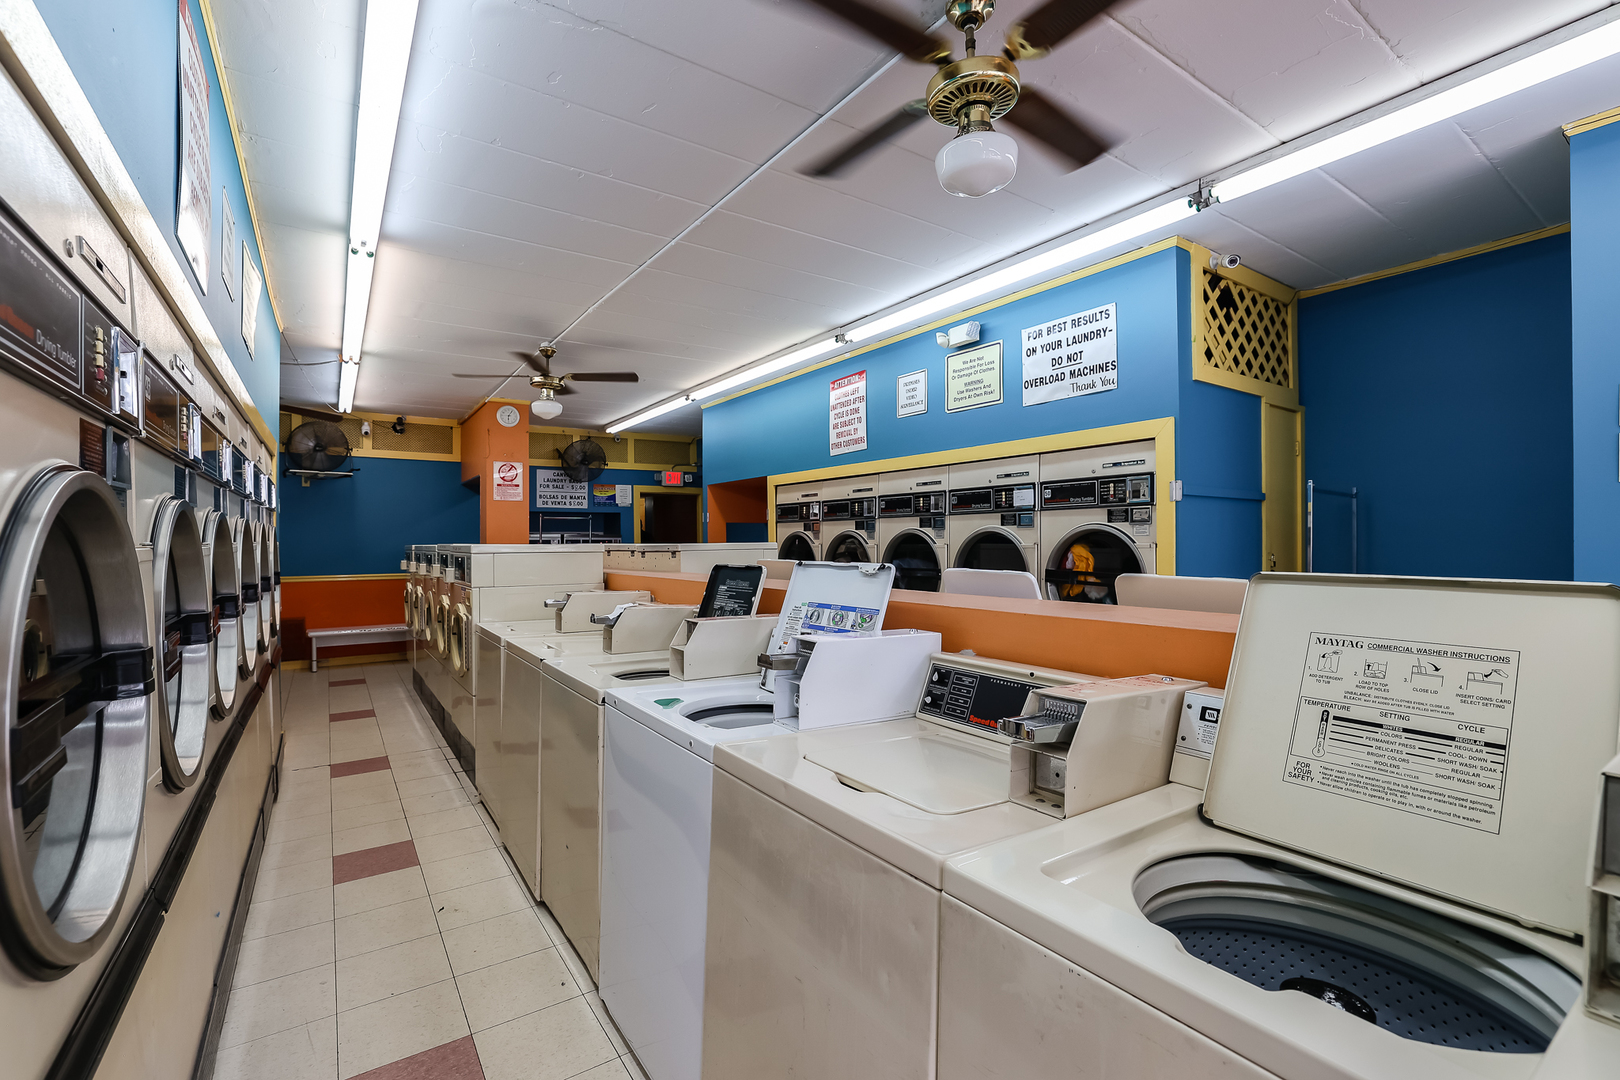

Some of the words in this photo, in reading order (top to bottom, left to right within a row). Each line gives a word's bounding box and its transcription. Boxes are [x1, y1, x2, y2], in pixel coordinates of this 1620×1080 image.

[1027, 328, 1043, 341] FOR
[1046, 321, 1067, 336] BEST
[1071, 309, 1110, 329] RESULTS
[36, 328, 57, 359] Drying
[57, 343, 77, 370] Tumbler
[1026, 346, 1037, 357] ON
[1040, 339, 1062, 353] YOUR
[1066, 327, 1113, 347] LAUNDRY-
[1051, 356, 1063, 367] DO
[1066, 350, 1083, 363] NOT
[952, 364, 976, 374] Responsible
[1024, 371, 1066, 390] OVERLOAD
[1069, 360, 1117, 380] MACHINES
[965, 385, 982, 393] Washers
[1070, 380, 1097, 393] Thank
[1100, 375, 1115, 387] You
[850, 387, 860, 397] LEFT
[831, 399, 851, 412] UNATTENDED
[852, 395, 865, 405] AFTER
[834, 410, 845, 421] CYCLE
[845, 409, 849, 417] IS
[849, 406, 860, 415] DONE
[840, 418, 856, 429] SUBJECT
[857, 416, 862, 424] TO
[836, 429, 853, 440] REMOVAL
[853, 427, 859, 436] BY
[831, 441, 843, 450] OTHER
[843, 436, 865, 448] CUSTOMERS
[666, 472, 681, 484] EXIT
[1315, 637, 1364, 649] MAYTAG
[1367, 643, 1414, 654] COMMERCIAL
[1415, 648, 1448, 657] WASHER
[1449, 651, 1510, 663] INSTRUCTIONS
[991, 678, 1021, 687] PERMANENT
[1304, 699, 1351, 712] TEMPERATURE
[969, 715, 990, 726] Speed
[1379, 711, 1410, 721] SETTING
[1382, 724, 1404, 732] WHITES
[1454, 737, 1486, 747] REGULAR
[1457, 724, 1485, 734] CYCLE
[1365, 736, 1397, 745] PERMANENT
[1398, 742, 1416, 750] PRESS
[1468, 755, 1488, 763] DOWN
[1380, 731, 1402, 739] COLORS
[1454, 745, 1483, 754] REGULAR
[1374, 745, 1403, 755] DELICATES
[1437, 757, 1457, 765] SHORT
[1293, 766, 1312, 776] YOUR
[1296, 761, 1311, 769] FOR
[1366, 751, 1386, 759] BRIGHT
[1387, 755, 1410, 764] COLORS
[1451, 768, 1480, 778] REGULAR
[1288, 771, 1314, 782] SAFETY
[1374, 760, 1400, 769] WOOLENS
[1435, 773, 1455, 781] SHORT
[1477, 782, 1495, 790] SOAK
[1362, 781, 1386, 790] containing
[1387, 786, 1410, 796] flammable
[1434, 798, 1457, 806] materials
[1468, 806, 1496, 815] petroleum
[1419, 788, 1446, 798] completely
[1447, 795, 1468, 803] stopped
[1469, 800, 1493, 809] spinning.
[1433, 809, 1451, 817] around
